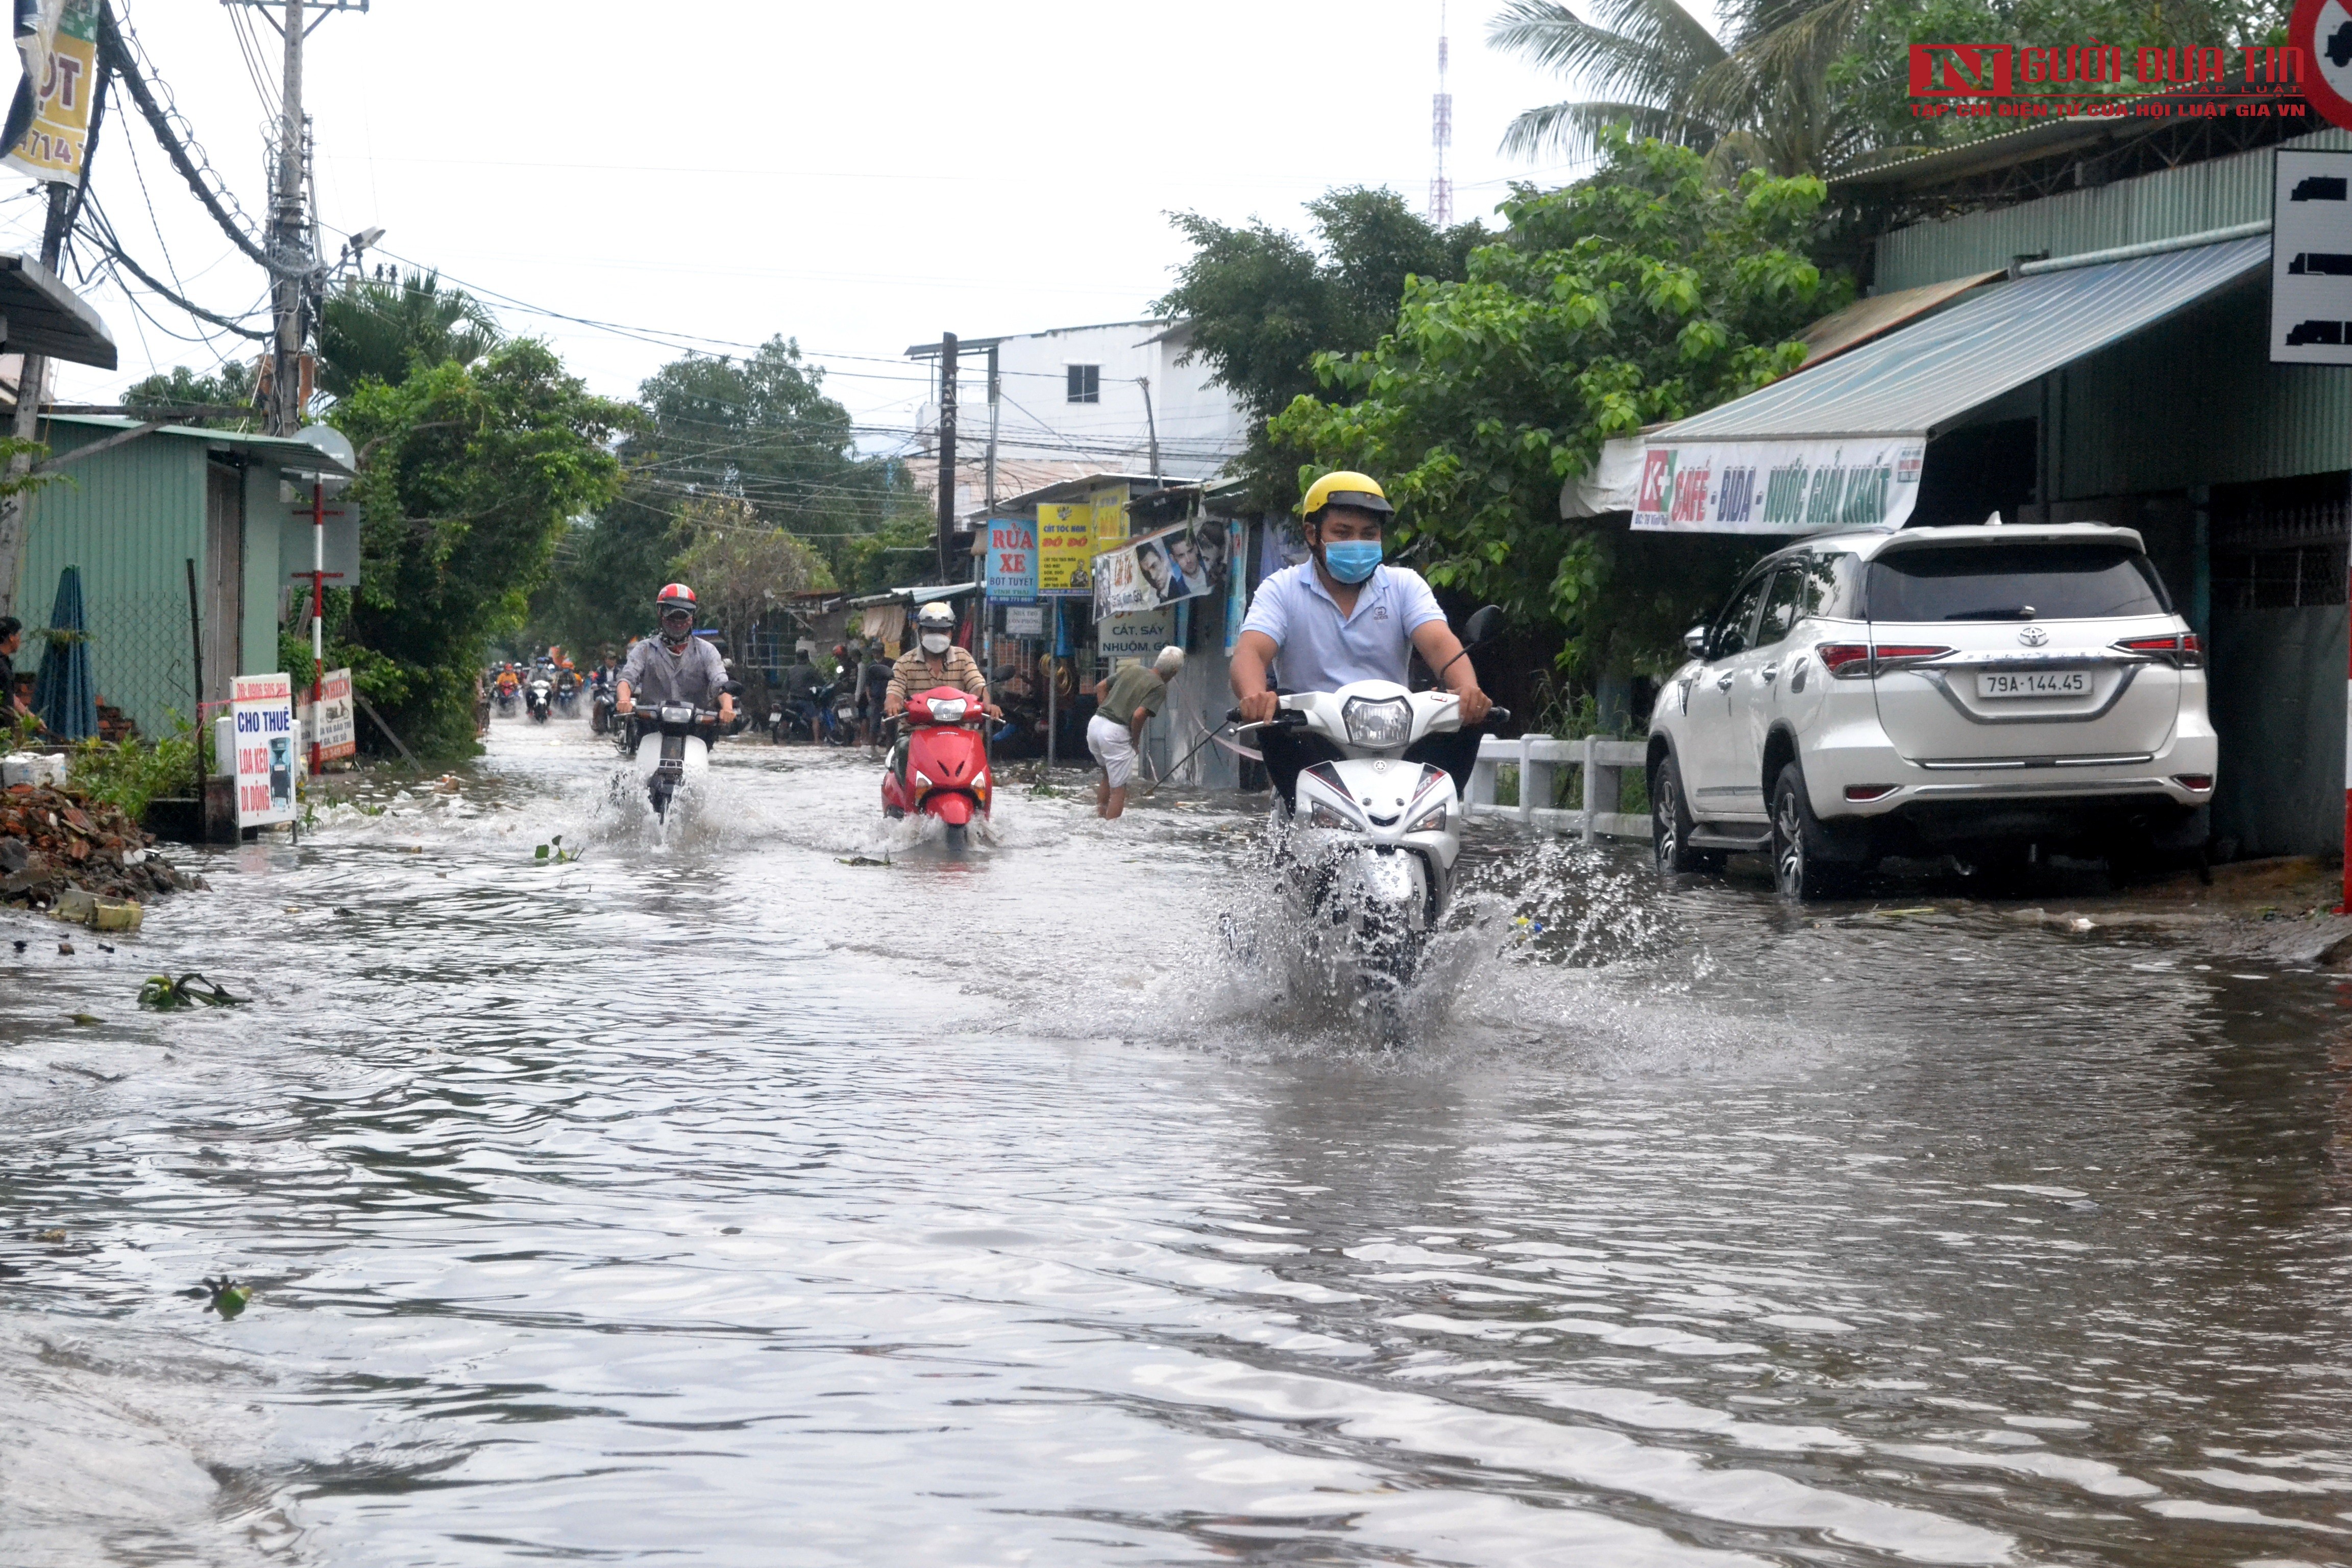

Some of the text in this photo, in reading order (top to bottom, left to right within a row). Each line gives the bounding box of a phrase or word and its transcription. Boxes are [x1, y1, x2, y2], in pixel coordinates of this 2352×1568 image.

[1717, 465, 1756, 522] BIDA
[1763, 453, 1810, 524] NƯỚC
[1806, 446, 1846, 524] GIẢI
[1841, 451, 1892, 524] KHÁT
[993, 522, 1034, 549] RỬA
[999, 553, 1026, 573] XE
[1987, 674, 2082, 692] 79A-144.45
[237, 706, 290, 732] CHO THUÊ
[239, 742, 268, 774] LOA KÉO
[241, 785, 249, 812] DI
